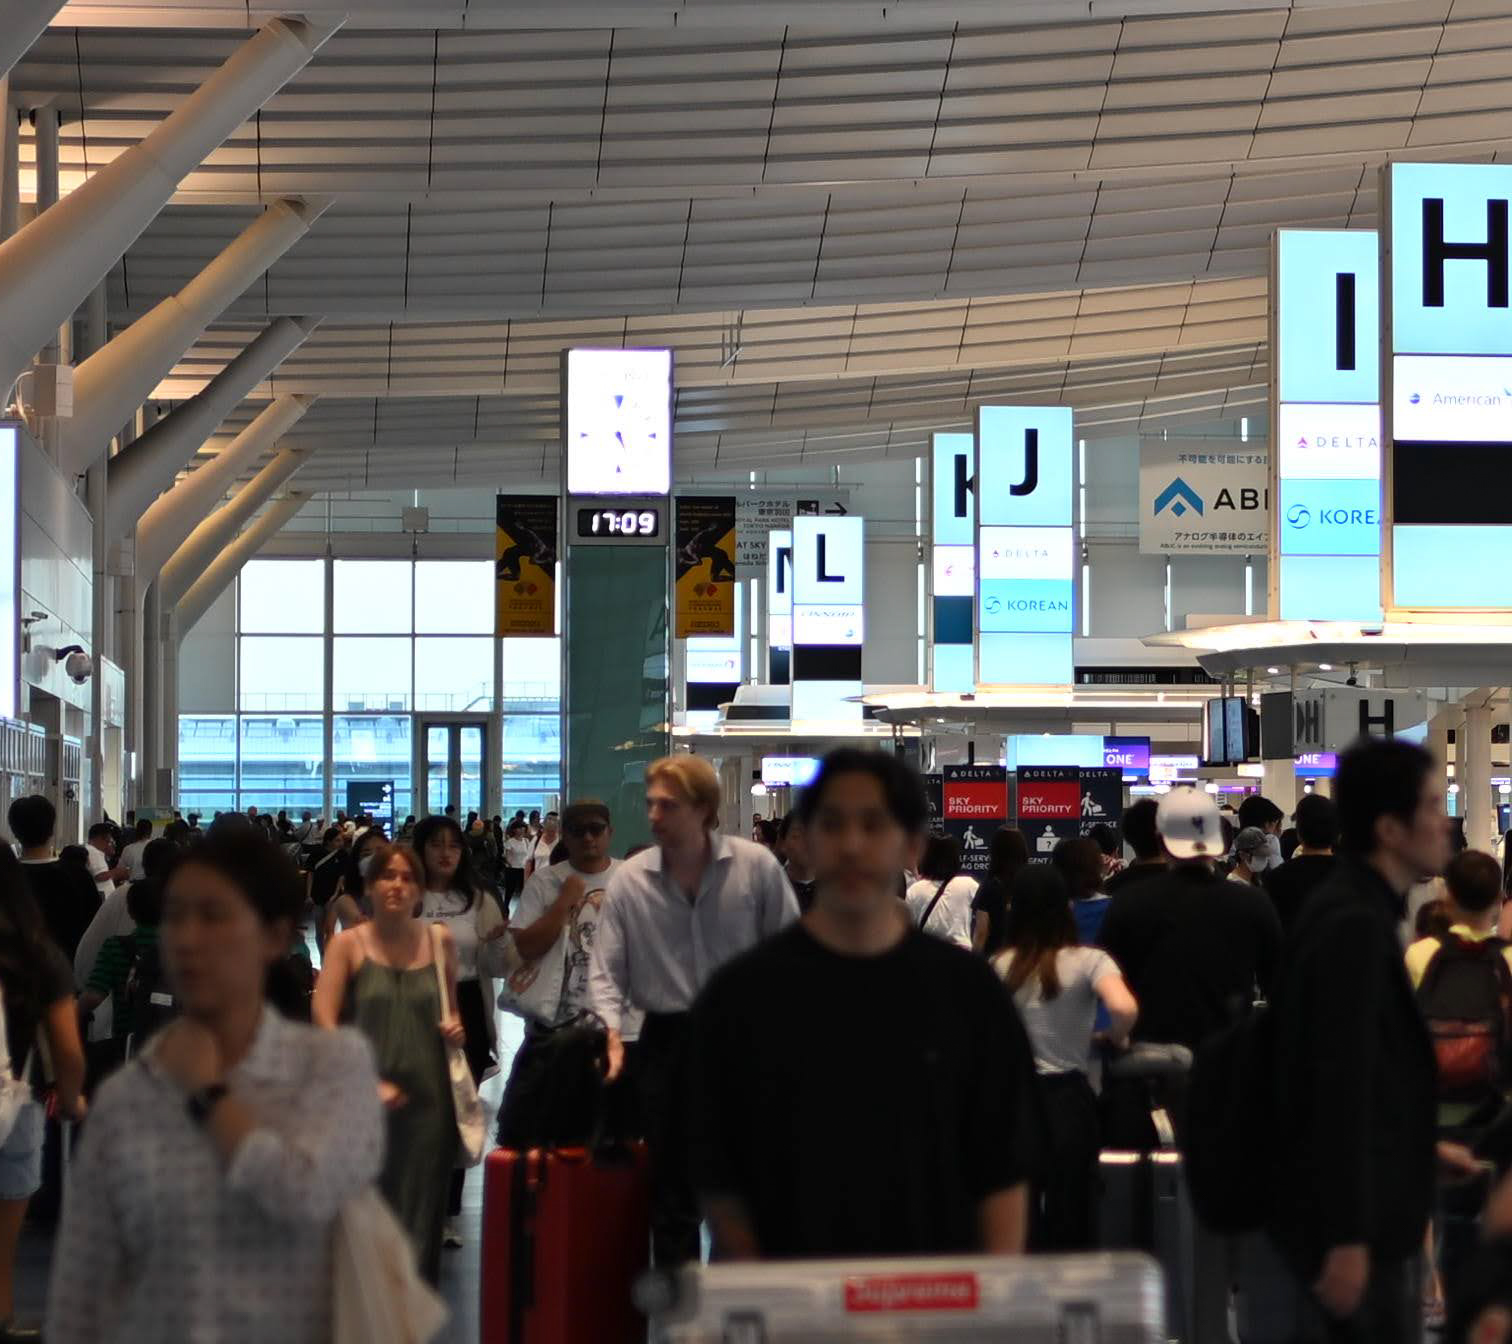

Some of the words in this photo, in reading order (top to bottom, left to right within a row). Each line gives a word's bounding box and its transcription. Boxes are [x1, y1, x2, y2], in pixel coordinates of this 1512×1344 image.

[1421, 197, 1509, 308] H
[1335, 272, 1356, 371] I
[1432, 392, 1502, 406] American
[1316, 436, 1378, 448] DELTA
[1009, 428, 1038, 496] J
[1320, 509, 1381, 525] KORE
[591, 512, 656, 535] 17:09
[816, 533, 846, 583] L
[1005, 549, 1049, 558] DELTA
[1007, 600, 1069, 611] KOREAN
[1106, 753, 1134, 766] ONE
[960, 769, 992, 778] DELTA
[1033, 769, 1065, 778] DELTA
[1079, 770, 1109, 779] DELTA
[948, 796, 971, 806] SKY
[1022, 796, 1043, 806] SKY
[948, 805, 1000, 814] PRIORITY
[1022, 805, 1073, 814] PRIORITY
